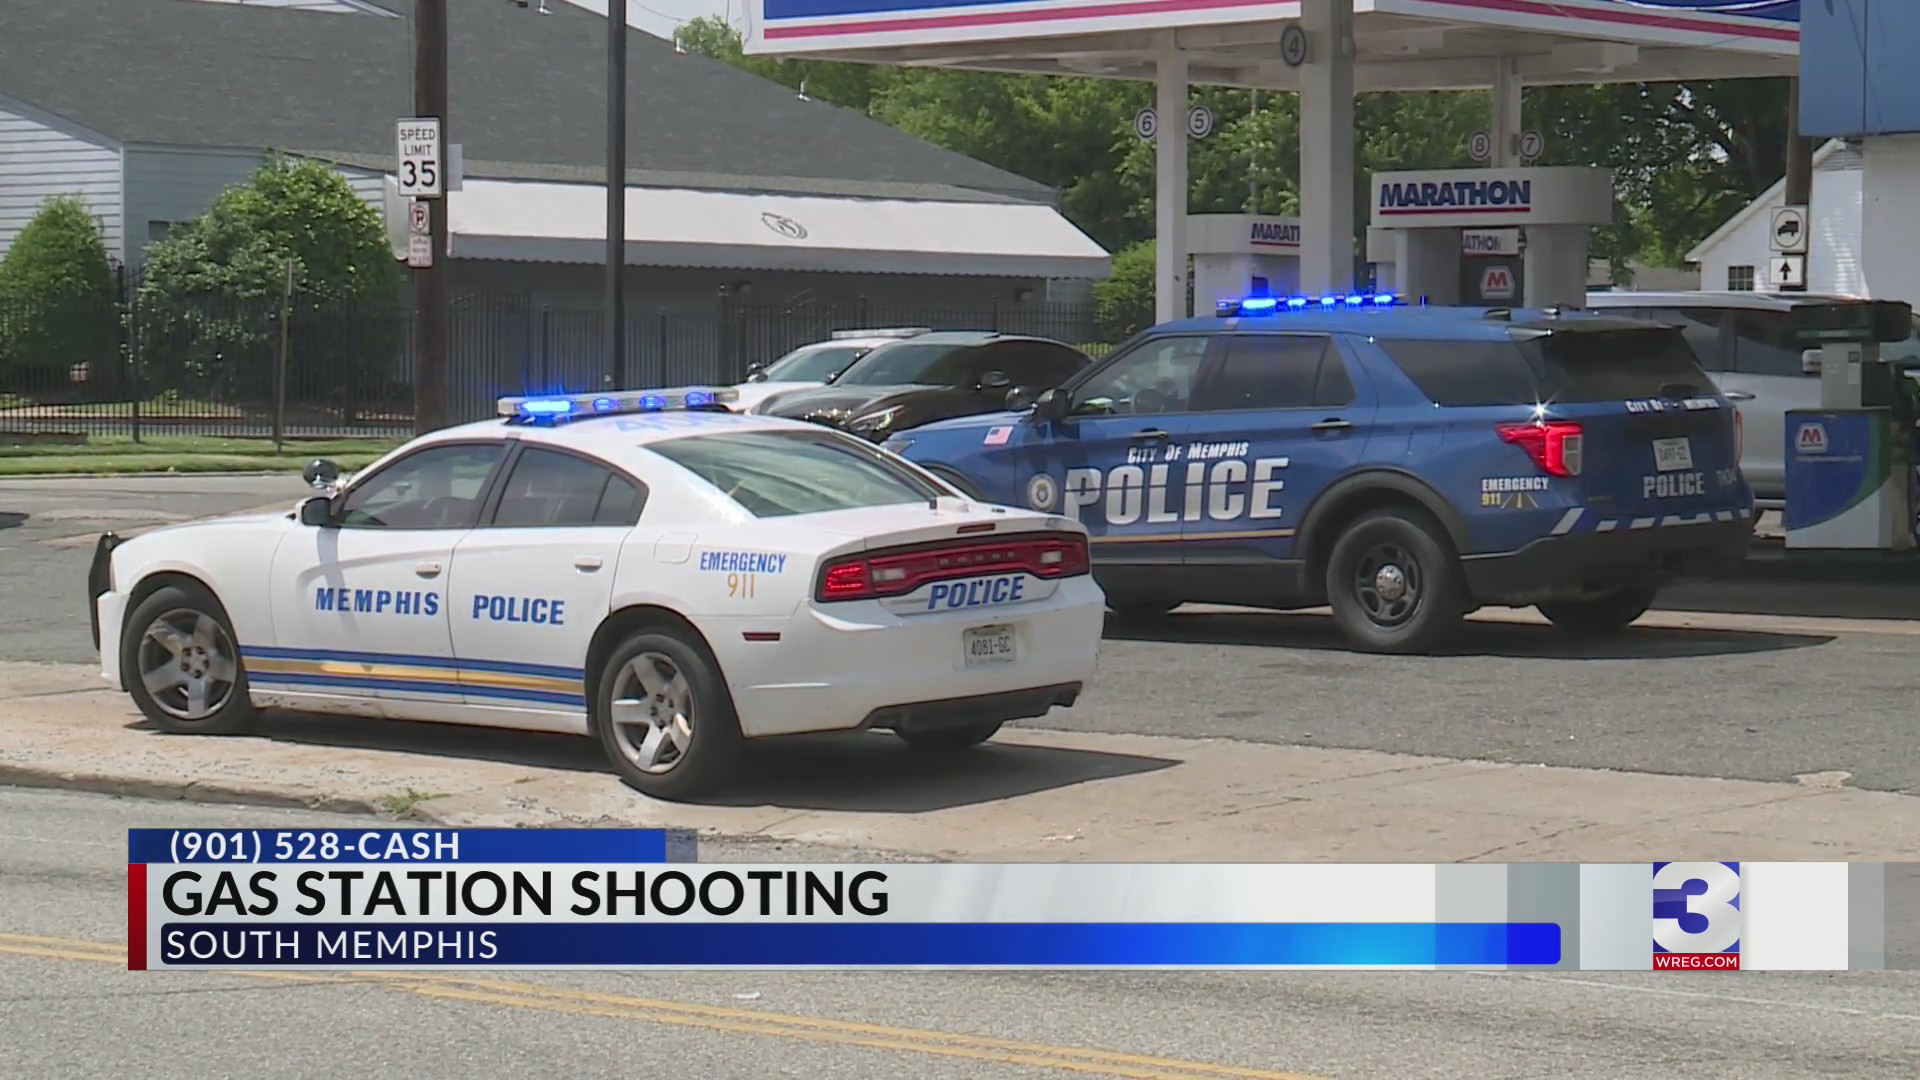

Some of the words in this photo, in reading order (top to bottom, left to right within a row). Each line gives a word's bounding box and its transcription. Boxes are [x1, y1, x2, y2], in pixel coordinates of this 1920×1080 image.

[1289, 36, 1299, 57] 4
[1142, 115, 1151, 131] 6
[1194, 113, 1204, 129] 5
[400, 129, 435, 140] SPEED
[405, 145, 431, 156] LIMIT
[1476, 137, 1484, 152] 8
[1526, 137, 1535, 152] 7
[403, 161, 435, 187] 35
[1380, 180, 1531, 207] MARATHON
[1487, 272, 1508, 287] M
[1801, 428, 1821, 442] M
[1128, 447, 1157, 464] CITY
[1165, 444, 1182, 462] OF
[1188, 442, 1249, 459] MEMPHIS
[1064, 457, 1289, 525] POLICE
[1482, 477, 1549, 491] EMERGENCY
[1643, 472, 1704, 498] POLICE
[1482, 492, 1501, 505] 911
[700, 551, 786, 573] EMERGENCY
[728, 573, 755, 599] 911
[928, 576, 1025, 610] POLICE
[316, 587, 439, 616] MEMPHIS
[473, 594, 565, 625] POLICE
